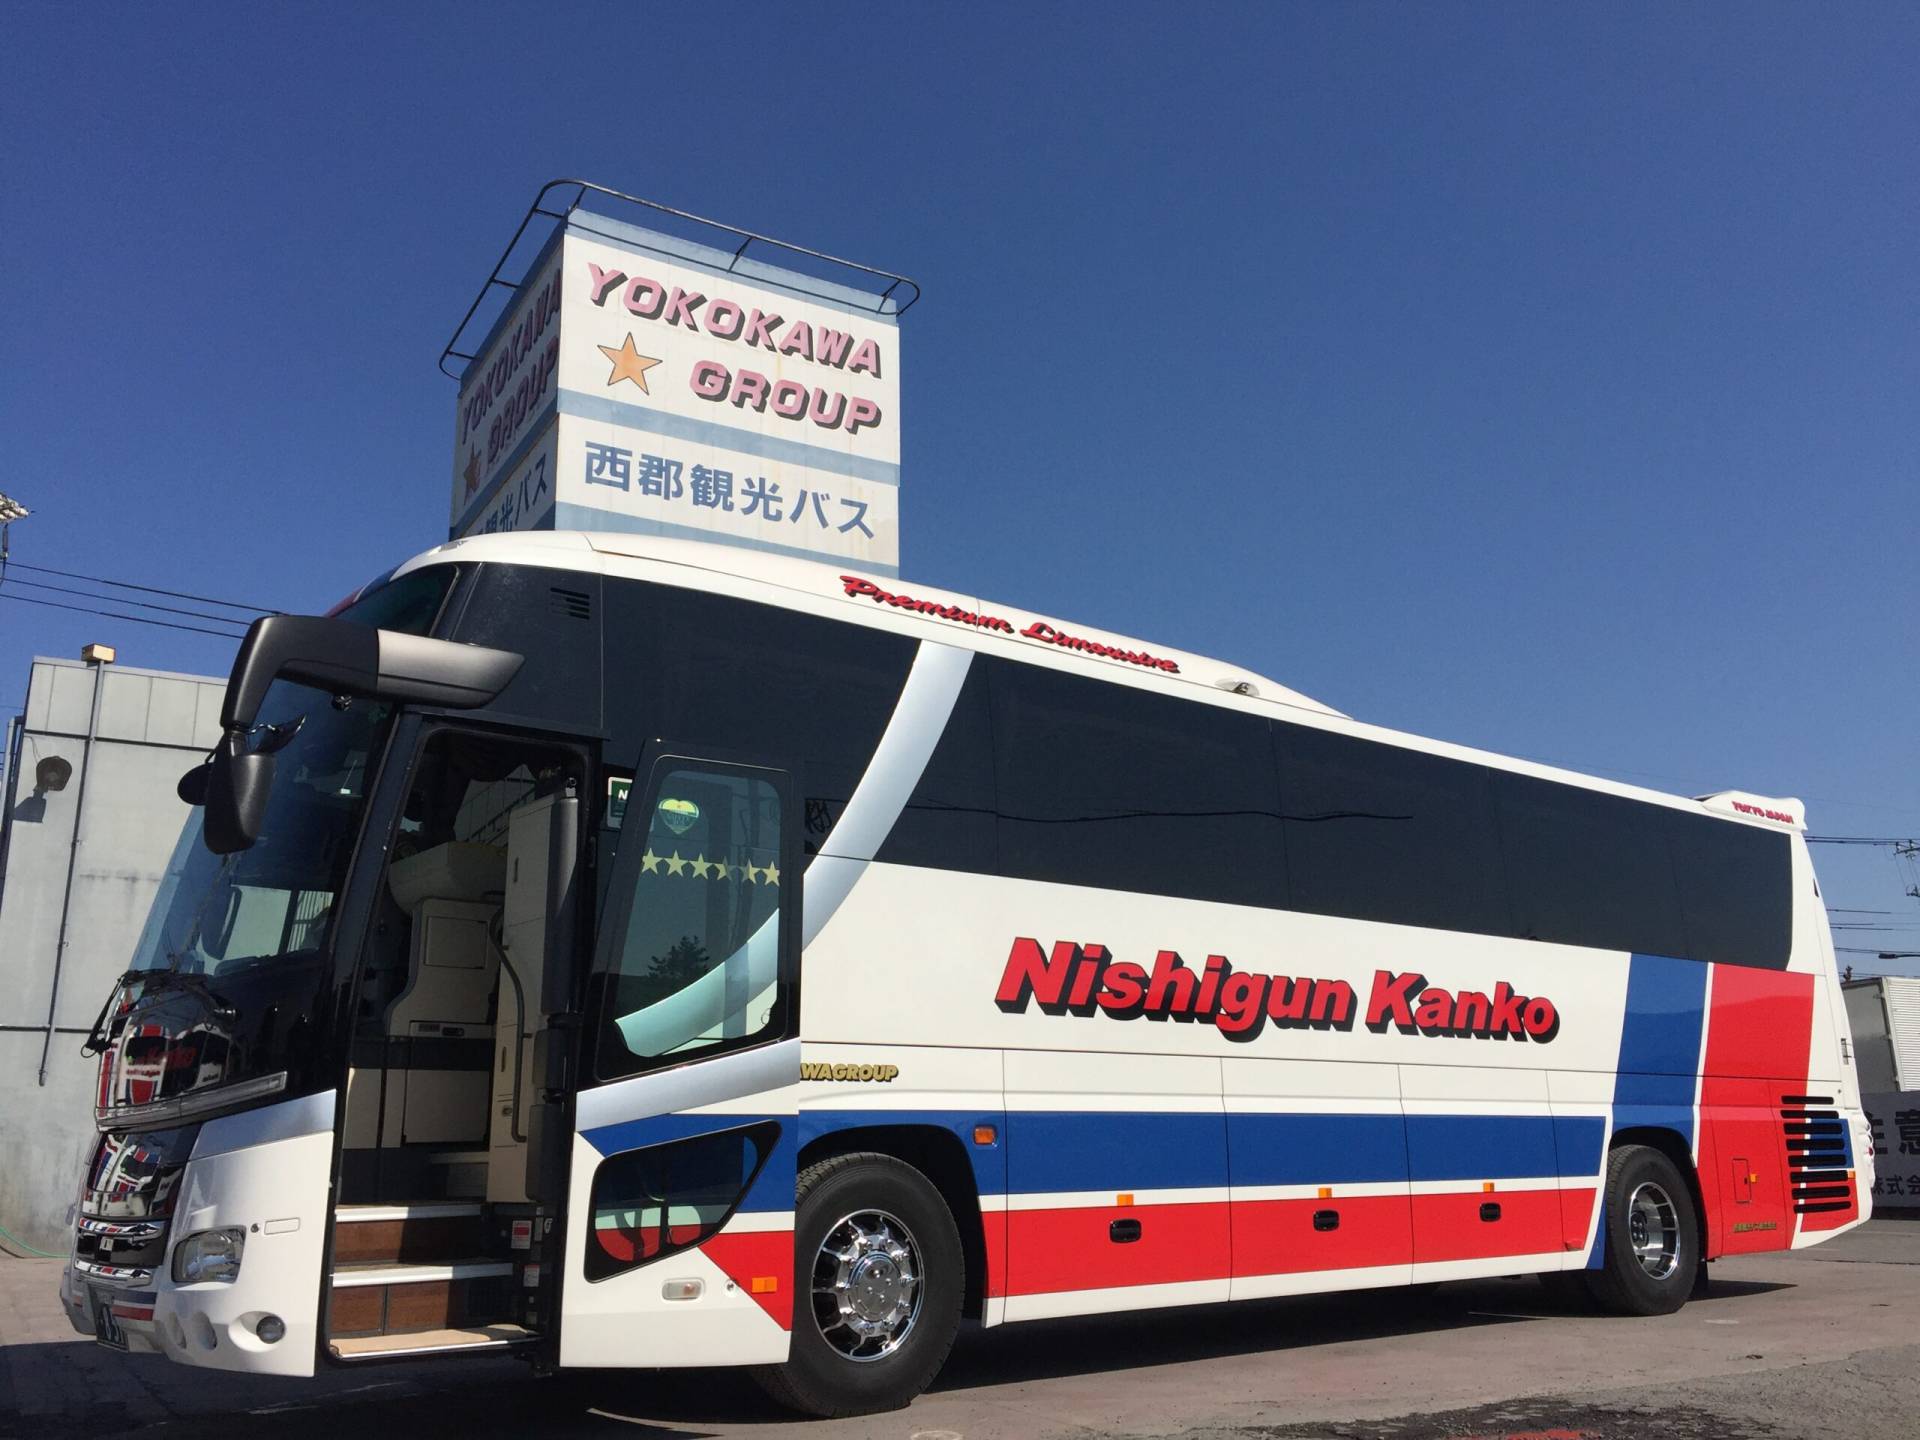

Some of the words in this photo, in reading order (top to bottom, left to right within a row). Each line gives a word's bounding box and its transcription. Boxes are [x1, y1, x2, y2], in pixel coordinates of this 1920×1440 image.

[587, 262, 883, 379] YOKOKAWA
[689, 359, 883, 436] GROUP
[584, 441, 875, 540] 西郡観光バス
[839, 575, 1015, 634] Premium
[1019, 621, 1182, 675] Limousine
[995, 937, 1358, 1044] Nishigun
[1364, 969, 1561, 1045] Kanko
[800, 1063, 899, 1083] WAGROUP
